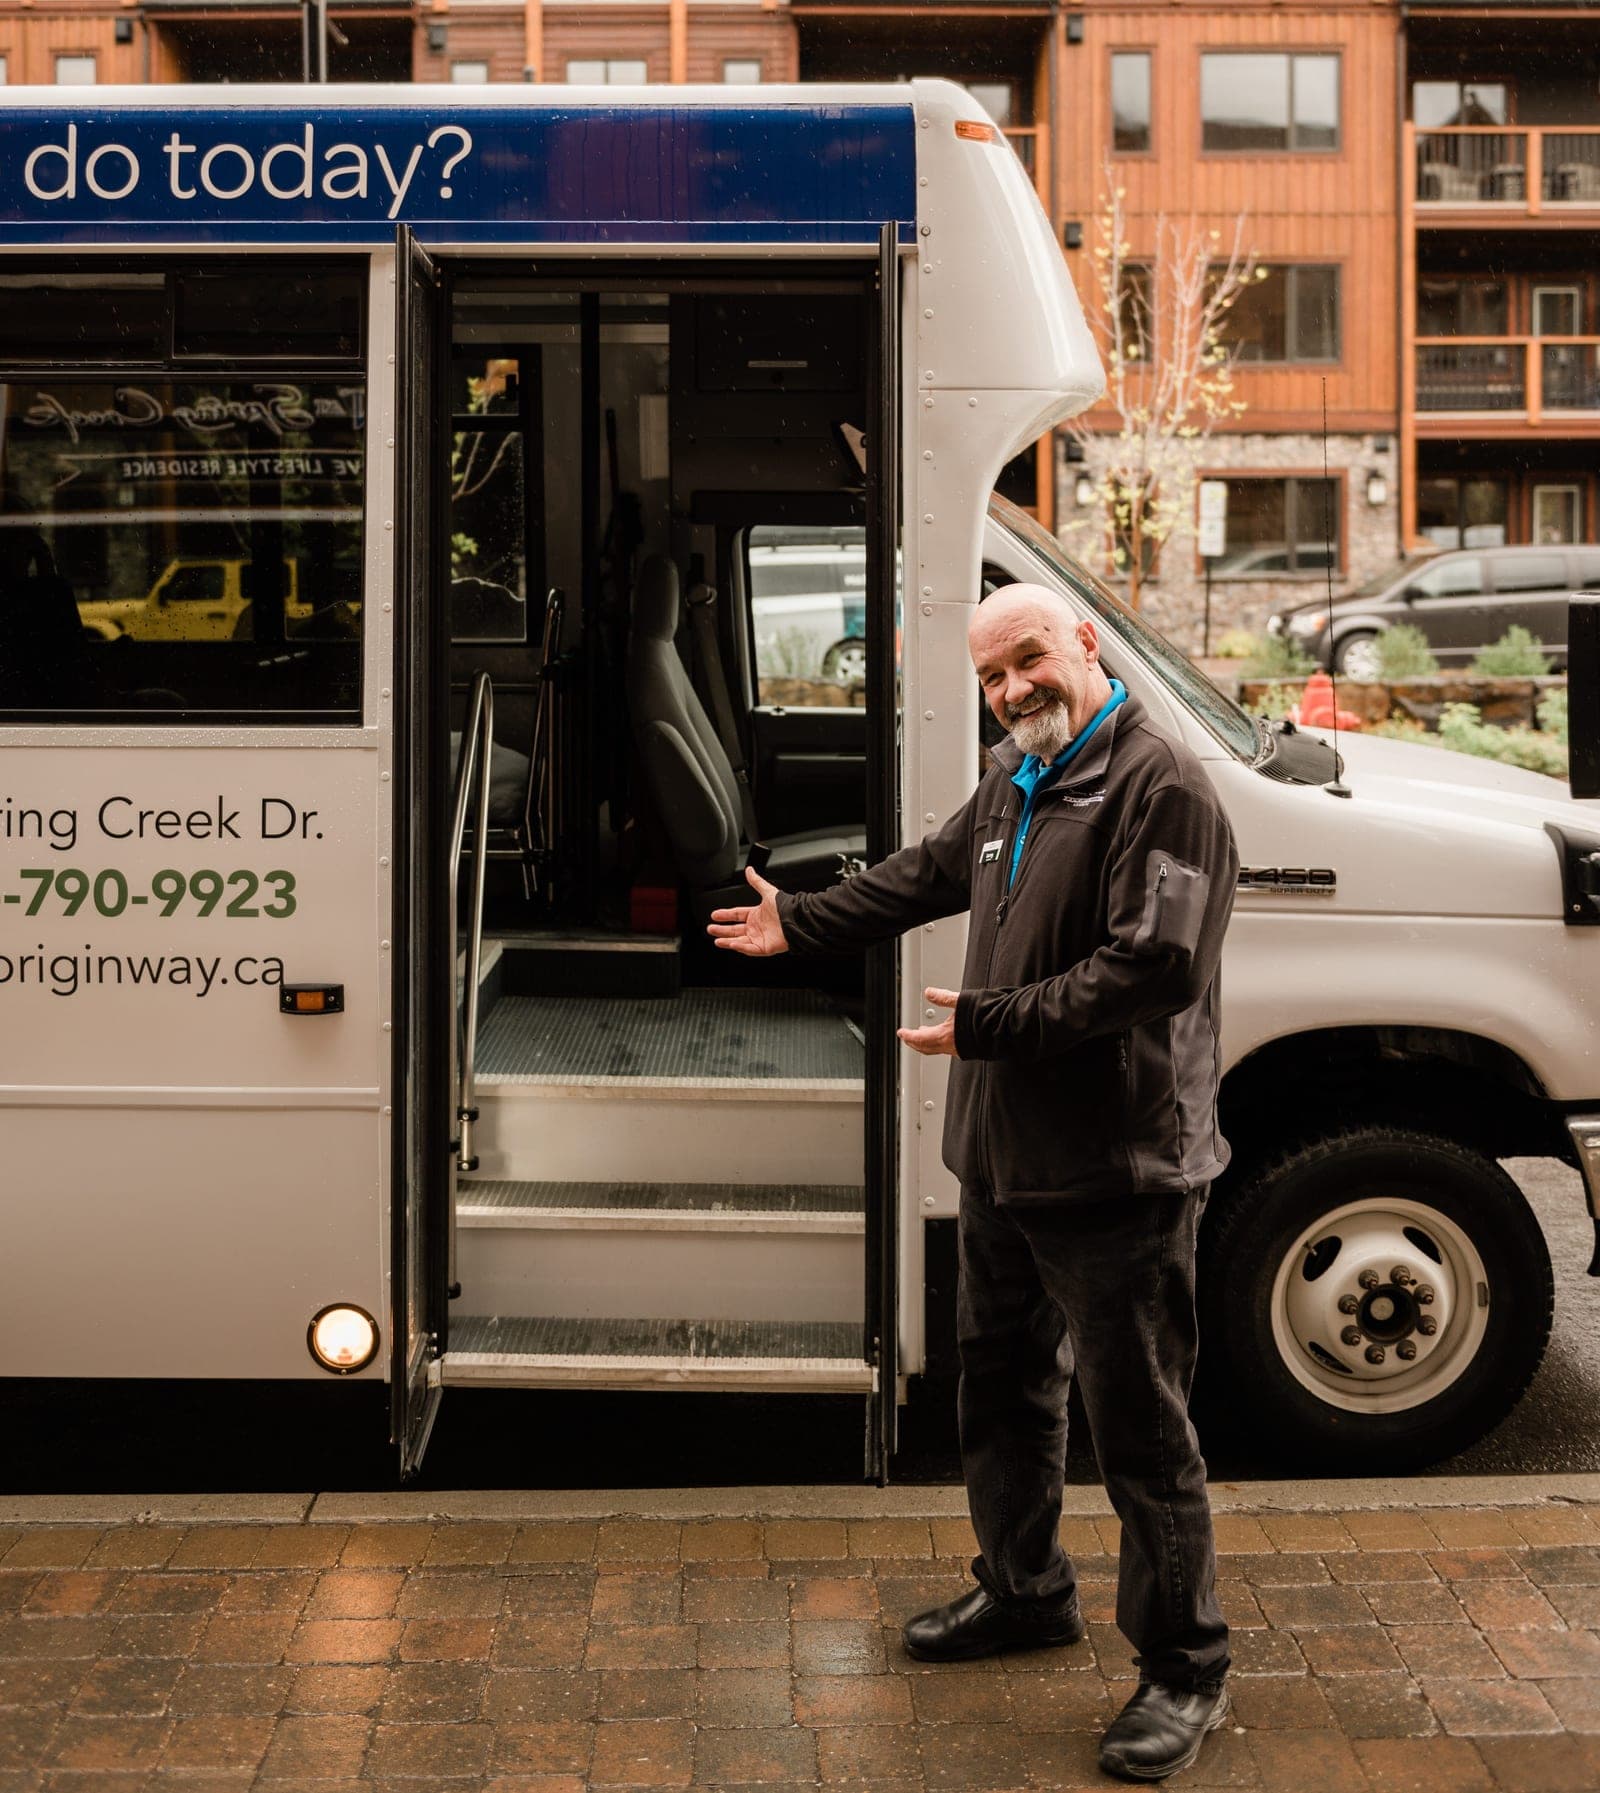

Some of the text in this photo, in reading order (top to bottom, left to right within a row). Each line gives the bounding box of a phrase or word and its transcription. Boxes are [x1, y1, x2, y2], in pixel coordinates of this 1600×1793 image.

[25, 122, 473, 220] do today?
[0, 795, 324, 851] ing Creek Dr.
